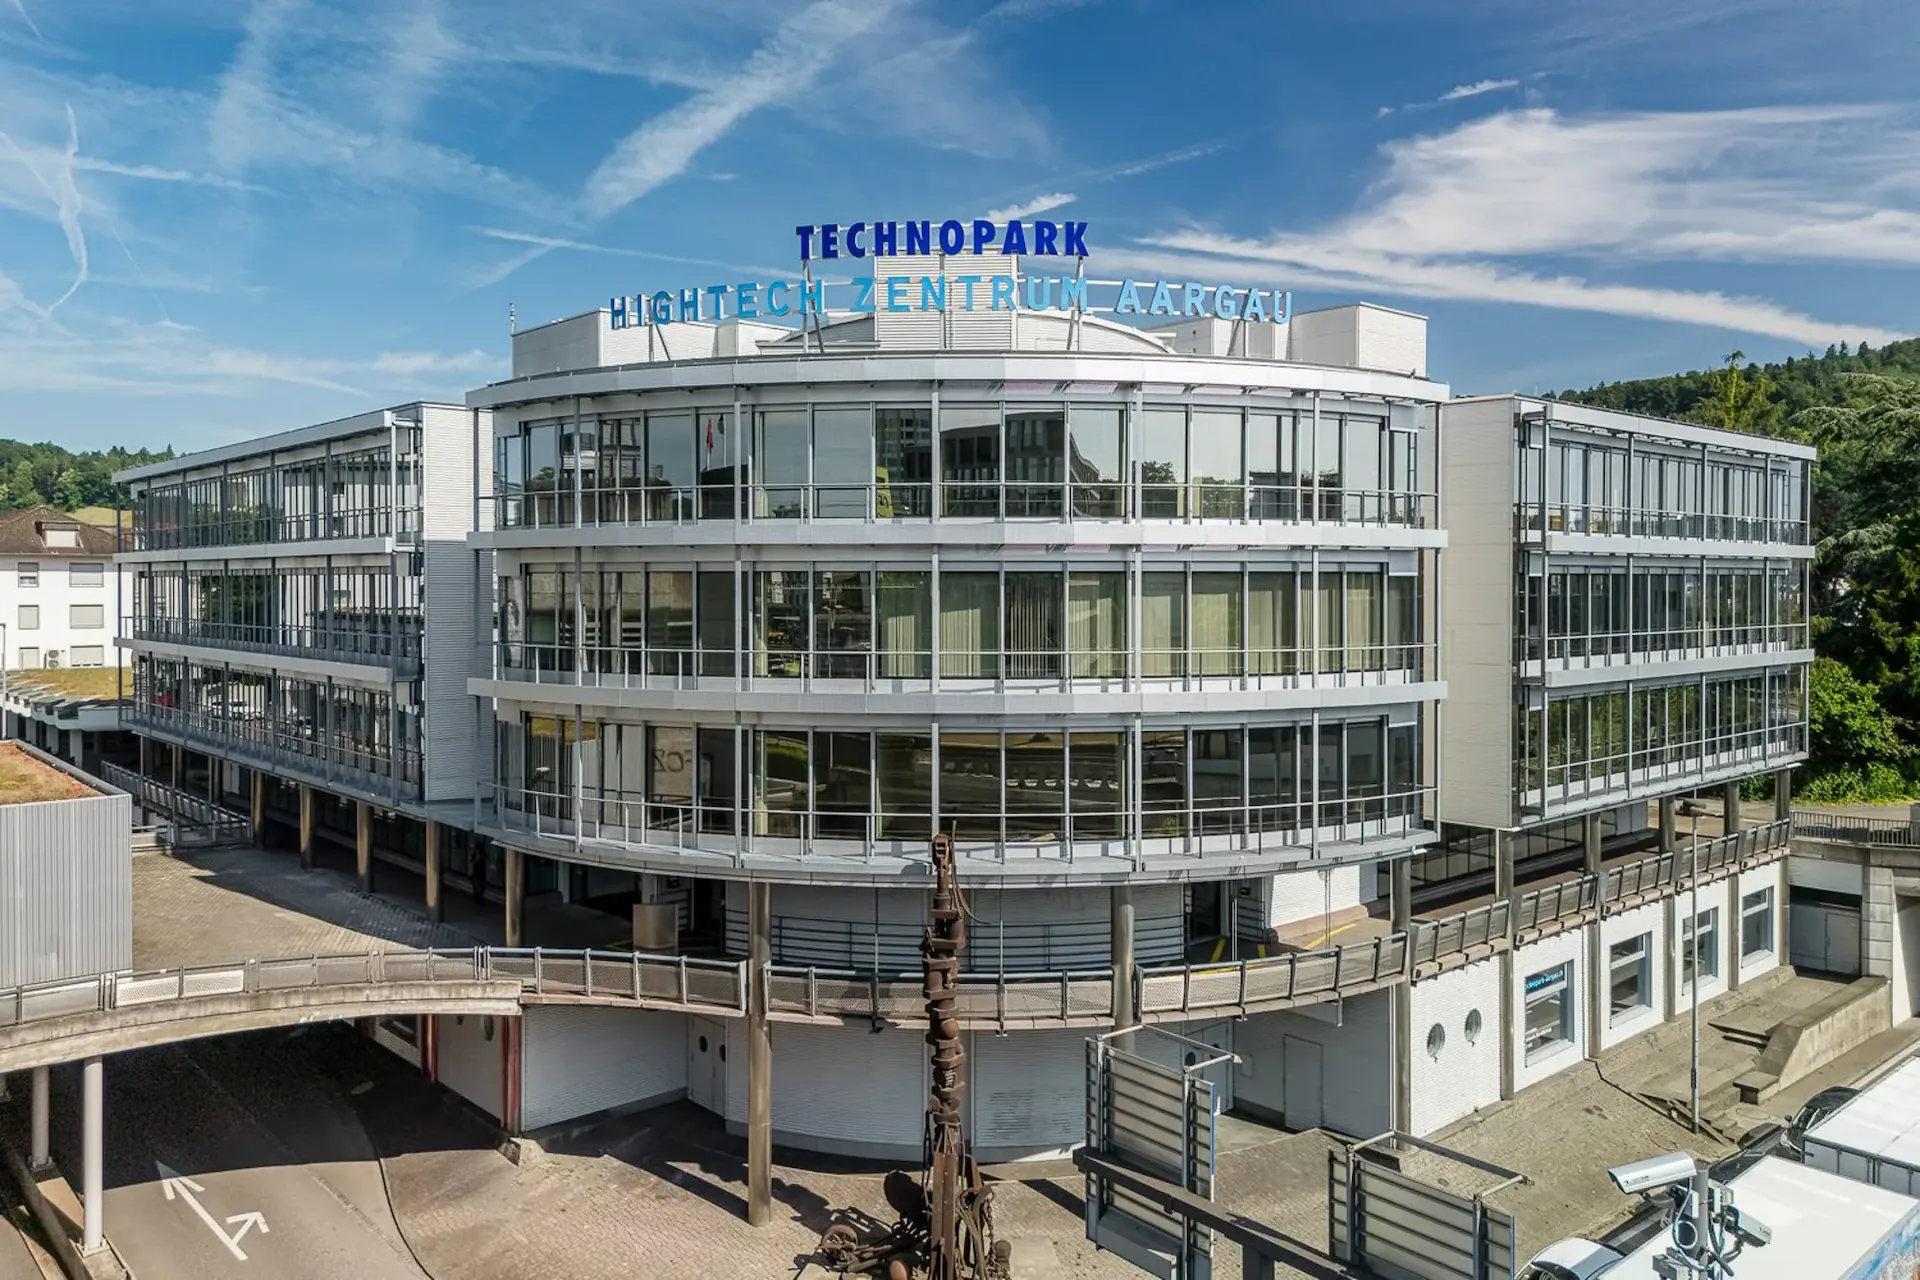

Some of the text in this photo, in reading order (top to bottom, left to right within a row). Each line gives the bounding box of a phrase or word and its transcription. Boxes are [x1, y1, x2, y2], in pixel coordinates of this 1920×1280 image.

[796, 220, 1089, 261] TECHNOPARK
[610, 275, 1292, 330] HIGHTECH ZENTRUM AARGAU
